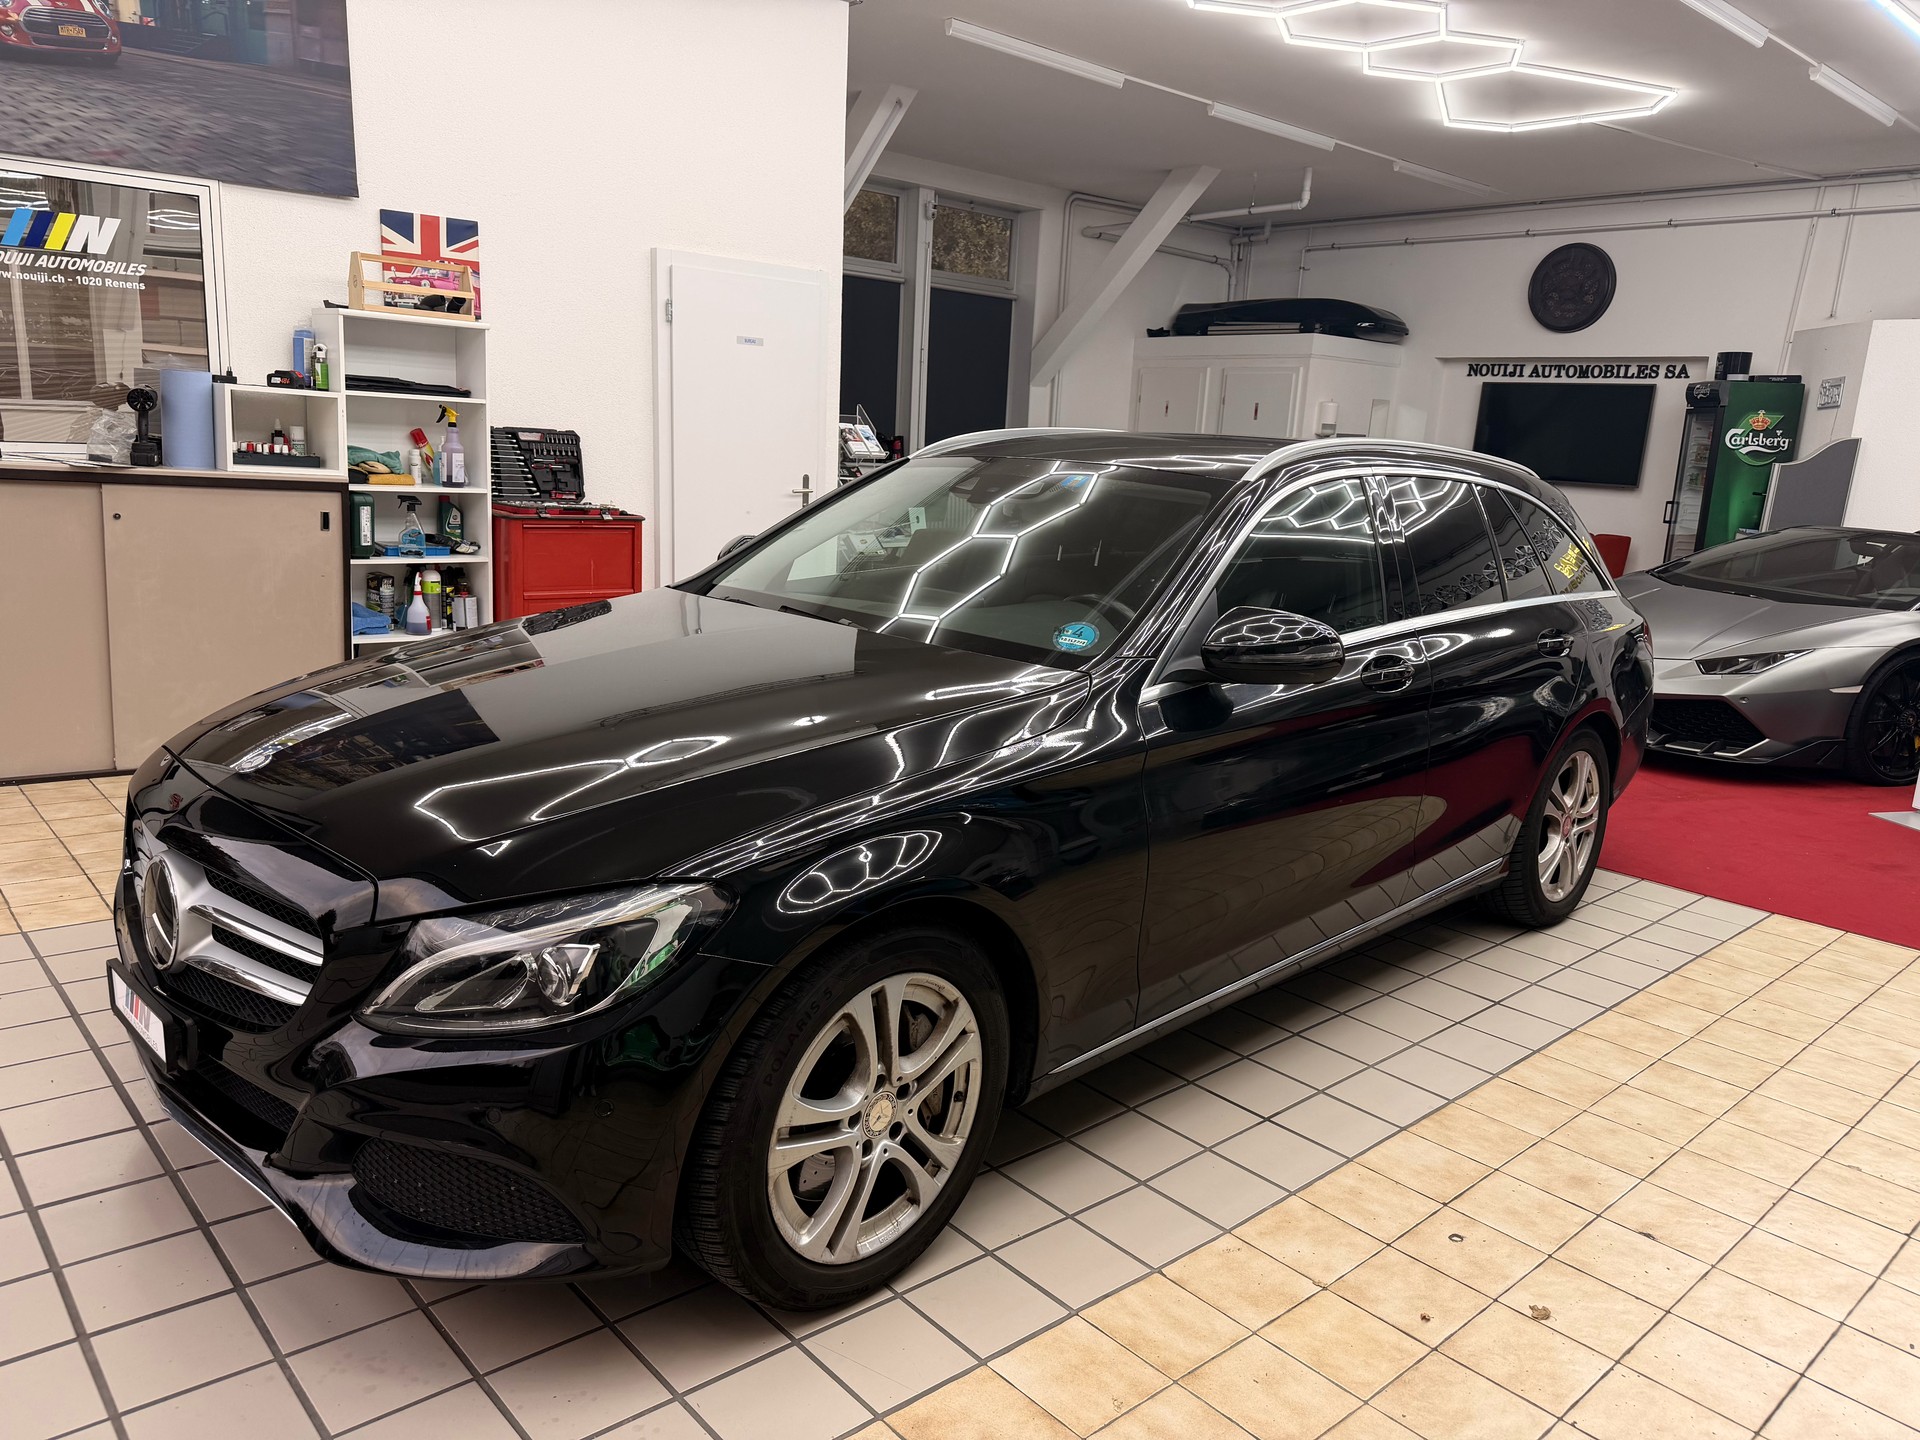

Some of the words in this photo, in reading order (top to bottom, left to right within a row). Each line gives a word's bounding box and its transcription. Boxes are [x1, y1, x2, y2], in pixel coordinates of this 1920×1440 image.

[35, 255, 147, 277] AUTOMOBILES
[0, 270, 65, 284] w.nouiji.ch
[76, 275, 102, 287] 1020
[105, 278, 146, 290] Renens
[1467, 363, 1526, 378] NOUIJI
[1528, 364, 1660, 379] AUTOMOBILES
[1664, 364, 1690, 379] SA
[1725, 428, 1790, 454] Carlsberg
[763, 1001, 821, 1086] POLARIS
